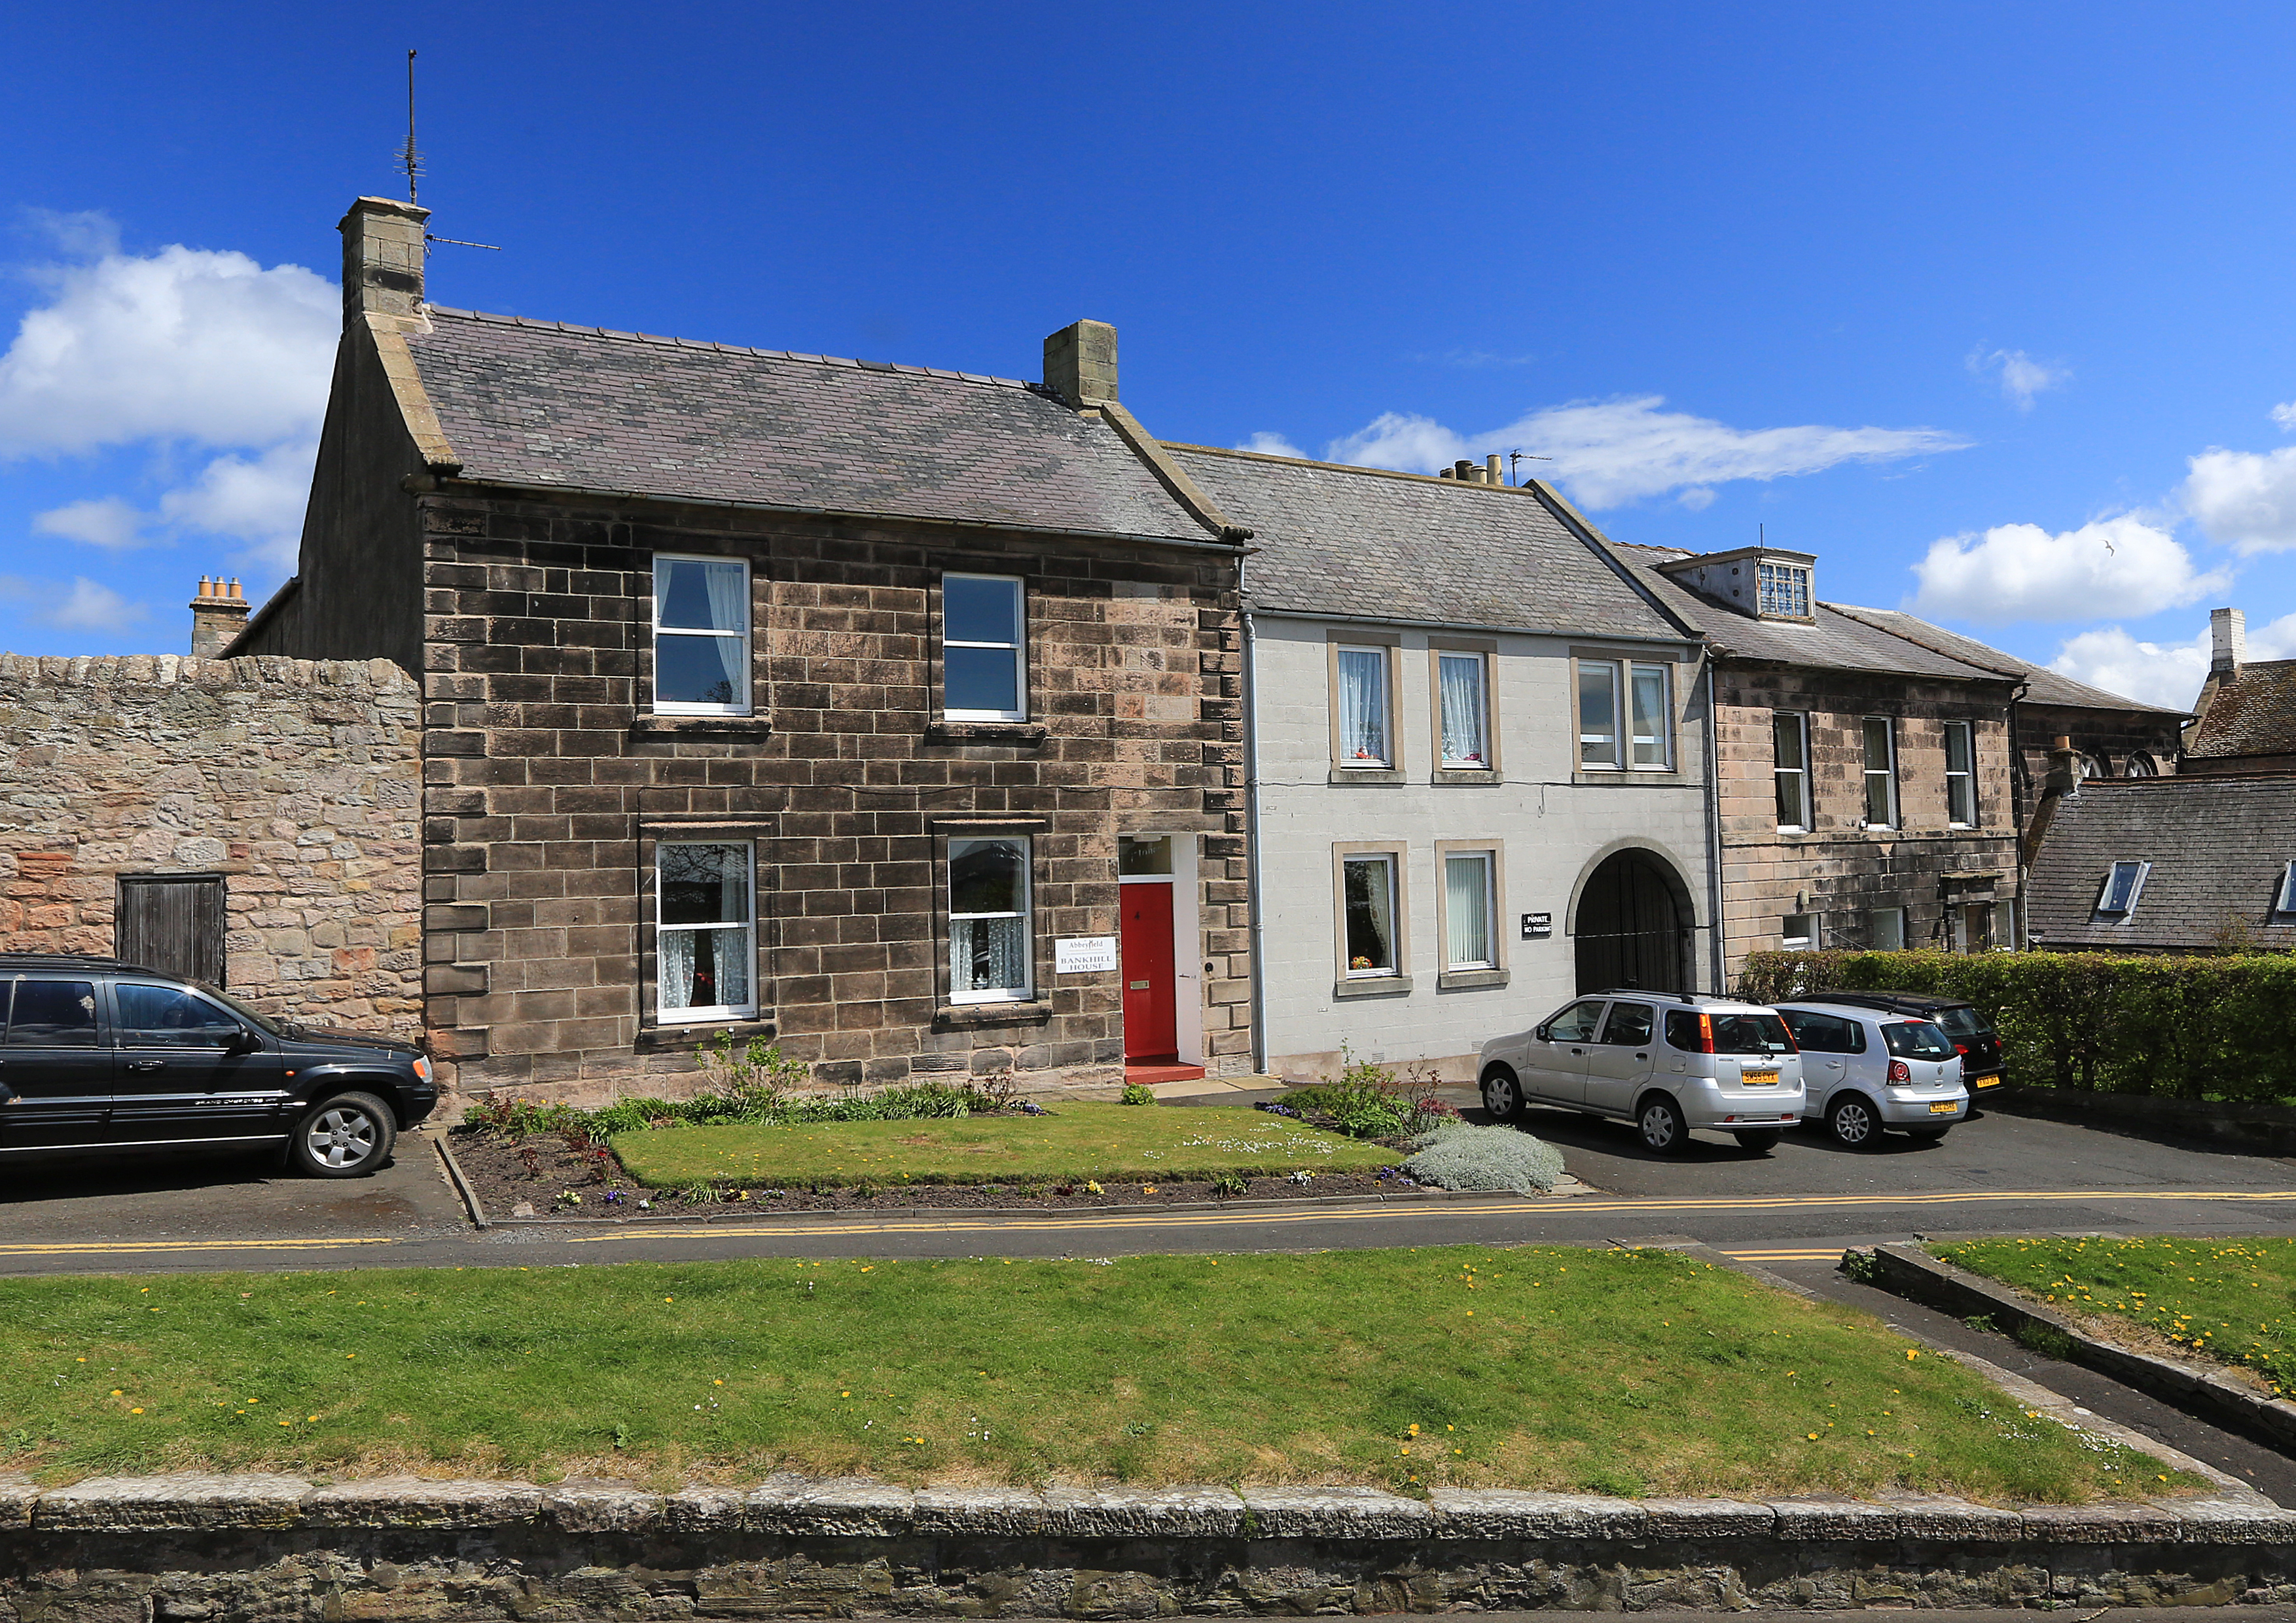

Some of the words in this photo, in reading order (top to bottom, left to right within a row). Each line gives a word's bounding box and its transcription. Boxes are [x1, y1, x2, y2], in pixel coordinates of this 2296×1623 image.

[1069, 940, 1103, 950] Abbeyfield
[1061, 955, 1112, 964] BANKHILL
[1069, 963, 1104, 971] HOUSE
